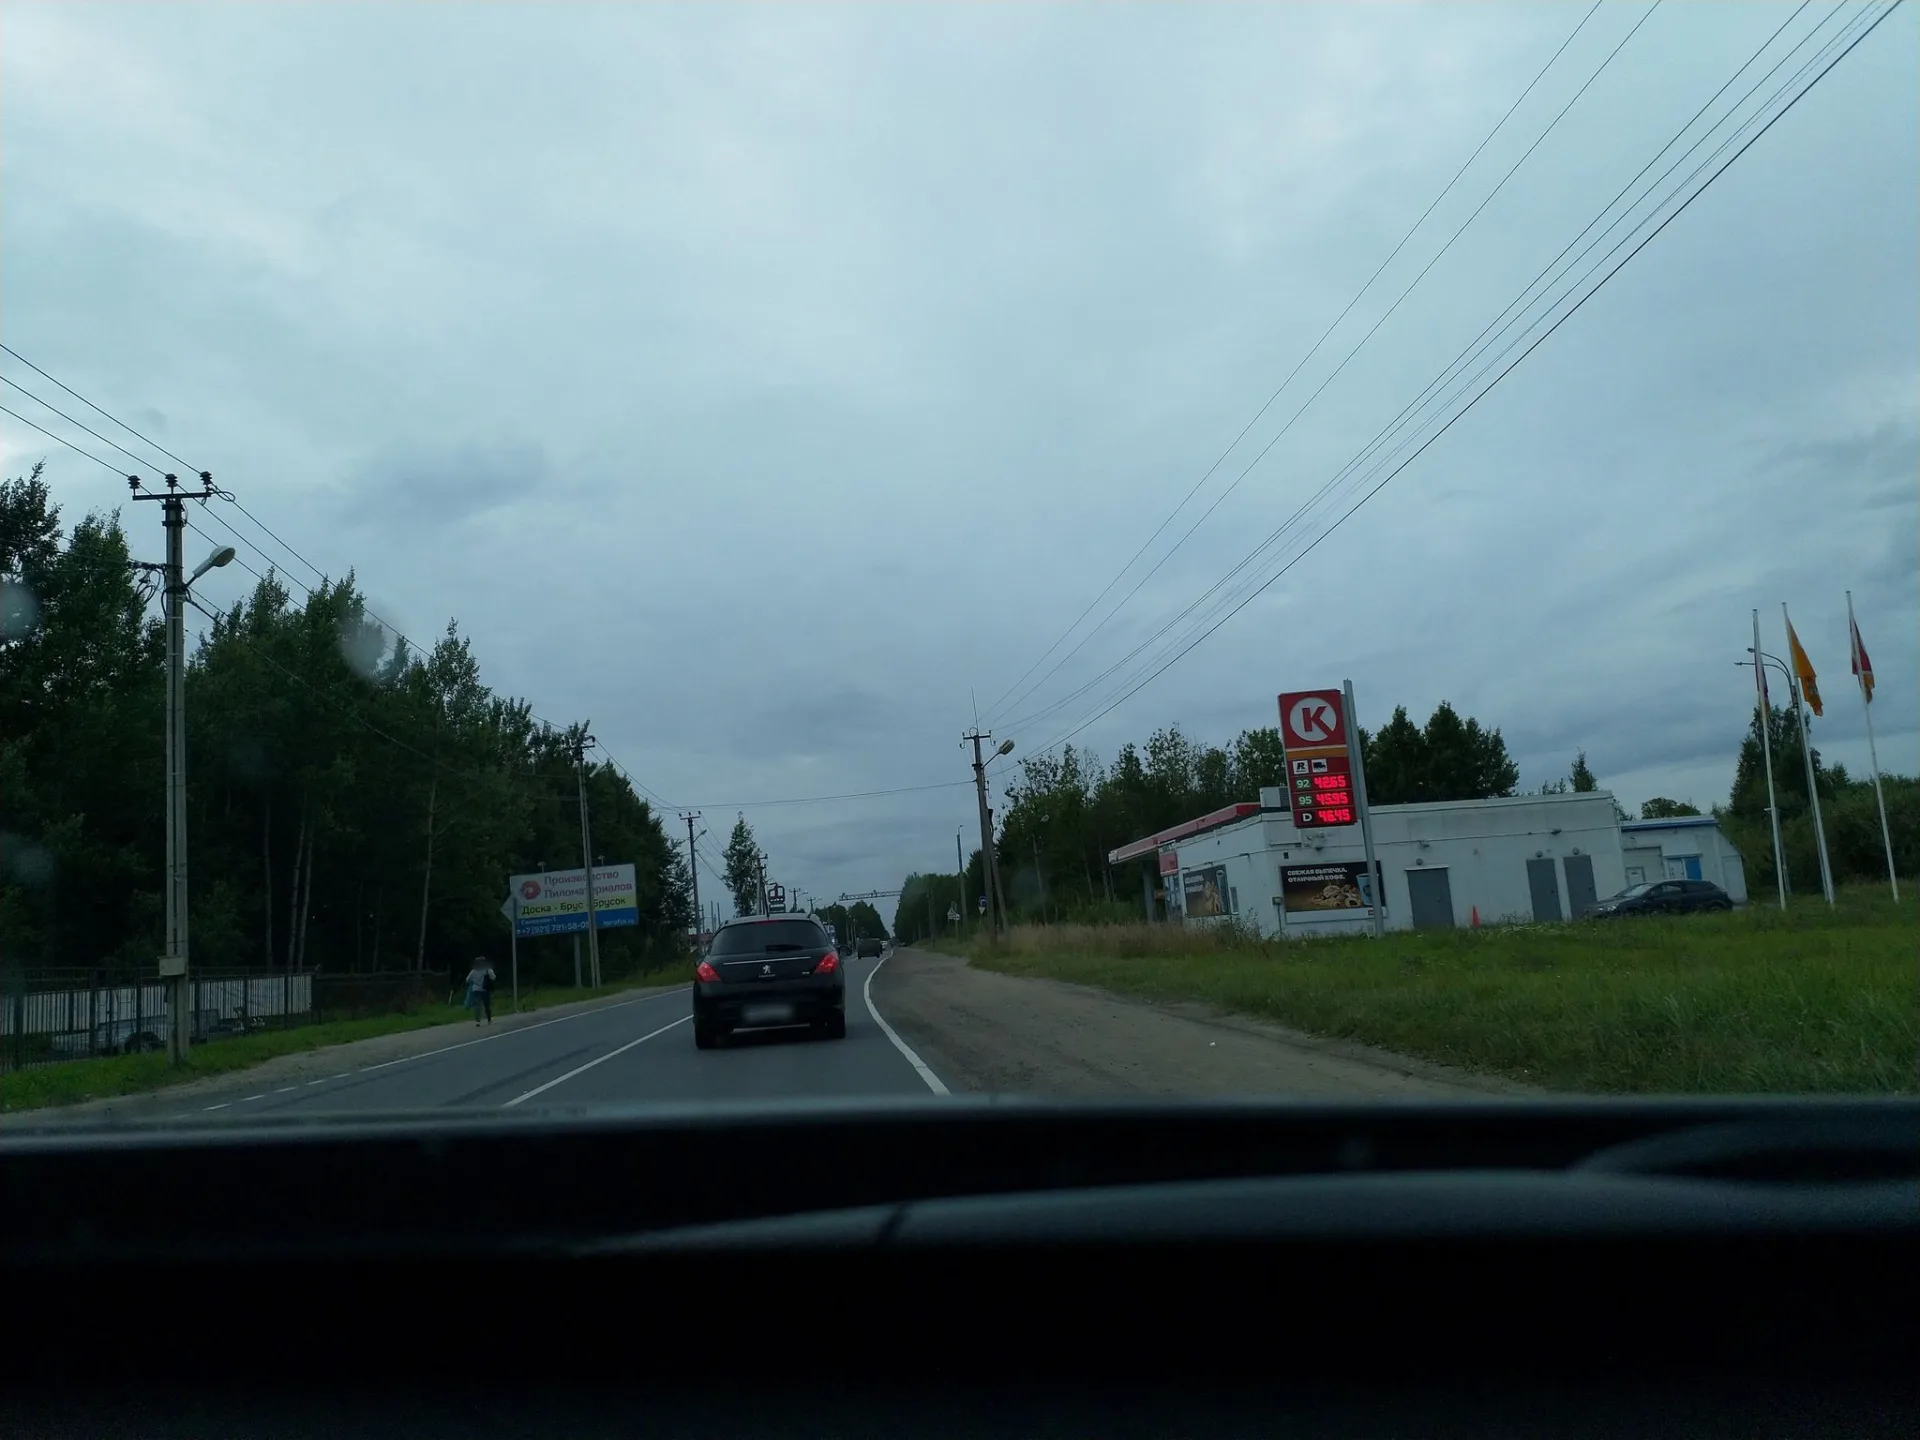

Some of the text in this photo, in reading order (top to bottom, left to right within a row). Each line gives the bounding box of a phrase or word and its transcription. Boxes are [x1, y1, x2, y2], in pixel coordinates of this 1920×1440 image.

[1296, 780, 1310, 788] 92
[1298, 796, 1312, 805] 95
[1302, 813, 1312, 822] D
[522, 905, 551, 916] Доска
[560, 902, 583, 912] Брус
[593, 897, 626, 908] Брусок
